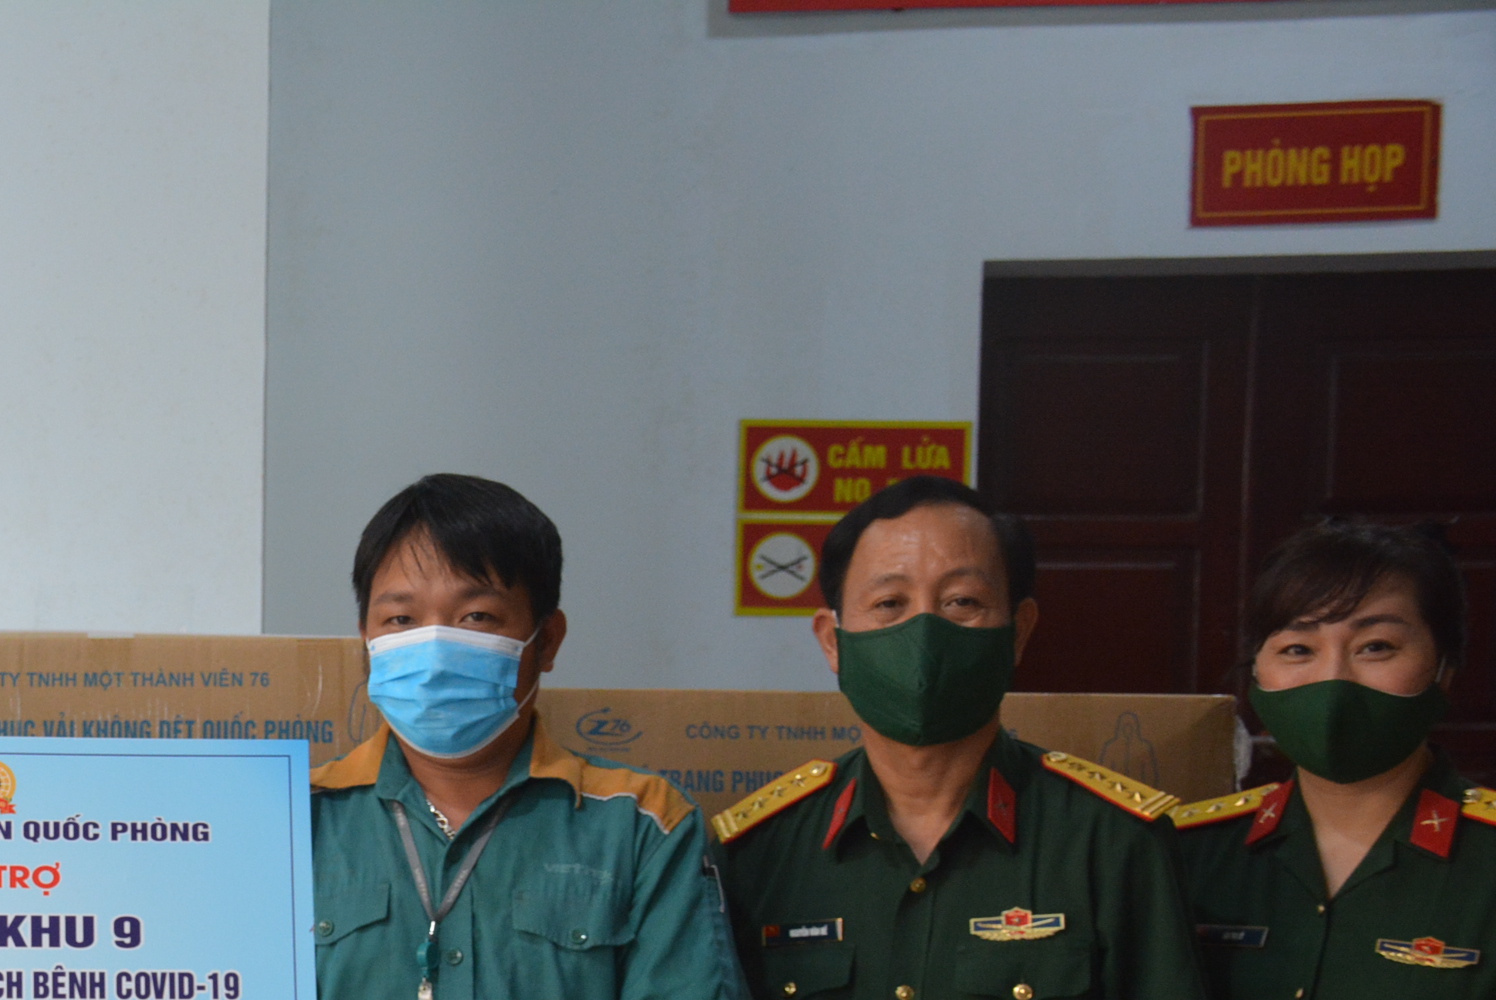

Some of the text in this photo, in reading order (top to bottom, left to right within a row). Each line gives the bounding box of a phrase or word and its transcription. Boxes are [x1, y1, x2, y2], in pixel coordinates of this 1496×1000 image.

[1221, 137, 1405, 193] PHÒNG HỌP
[827, 436, 950, 470] CẤM LỬA
[833, 478, 871, 503] NO
[27, 671, 77, 688] TNHH
[131, 667, 194, 688] THÀNH
[249, 671, 271, 688] 76
[747, 725, 769, 740] TY
[775, 725, 826, 741] TNHH
[23, 814, 100, 843] QUỐC
[110, 817, 210, 843] PHÒNG
[113, 916, 141, 949] 9
[116, 971, 240, 1000] COVID-19
